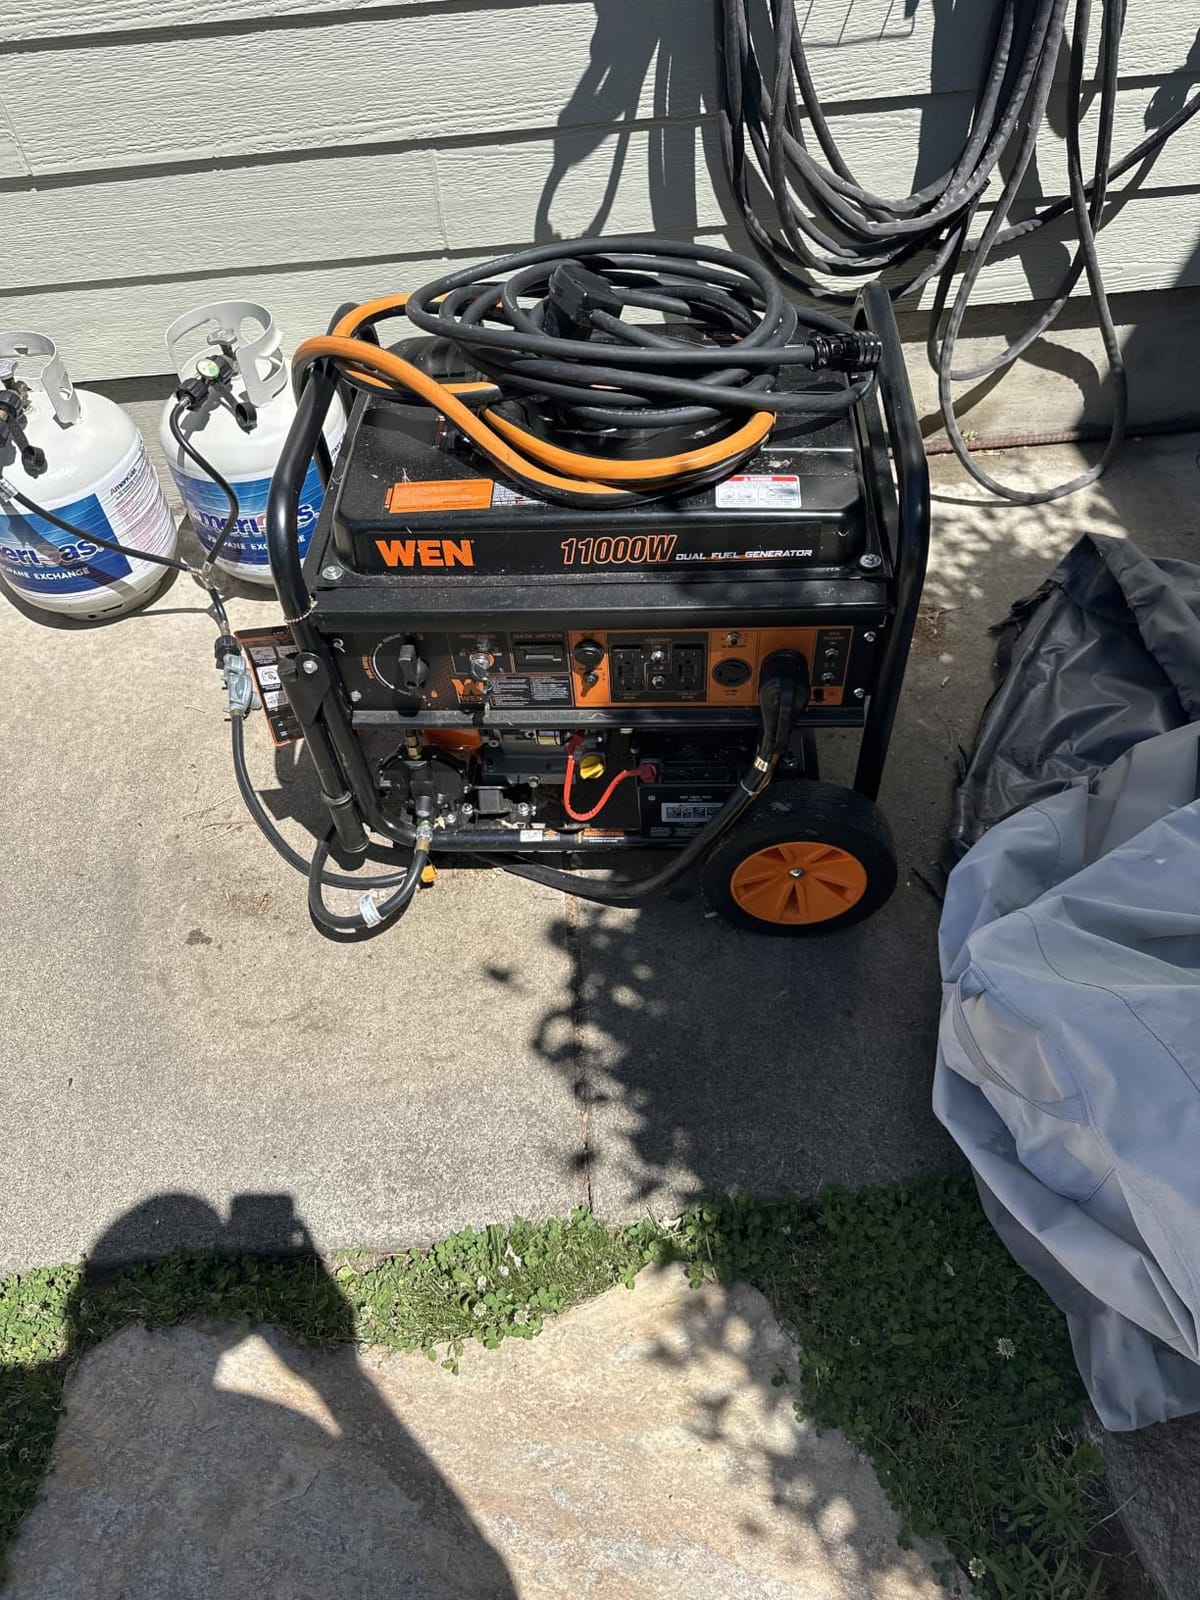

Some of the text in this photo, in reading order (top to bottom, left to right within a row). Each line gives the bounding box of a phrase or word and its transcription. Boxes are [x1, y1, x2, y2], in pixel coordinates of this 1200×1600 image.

[375, 540, 474, 566] WEN
[560, 534, 814, 565] 11000W DUAL FUEL GENERATOR
[33, 567, 91, 581] EXCHANGE
